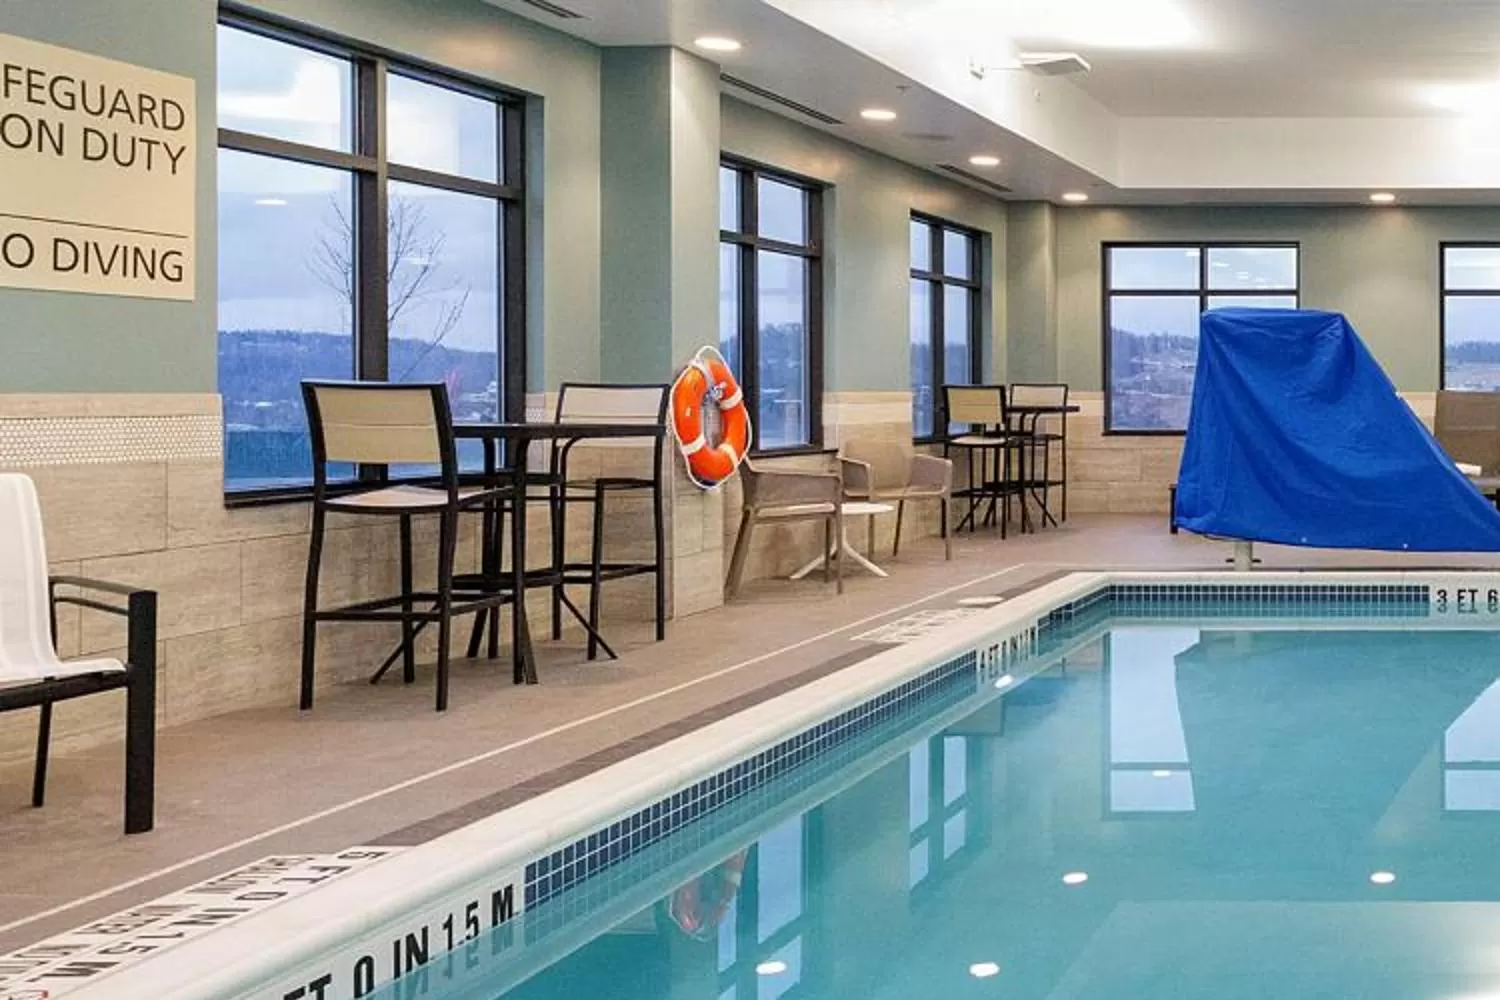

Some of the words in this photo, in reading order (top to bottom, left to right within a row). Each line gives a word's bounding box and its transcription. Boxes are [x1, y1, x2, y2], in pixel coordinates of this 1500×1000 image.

[3, 63, 185, 131] FEGUARD
[1, 113, 64, 157] ON
[82, 126, 187, 175] DUTY
[2, 233, 35, 269] O
[52, 237, 184, 282] DIVING
[1436, 588, 1449, 604] 3
[1456, 588, 1479, 604] FT
[1487, 588, 1500, 604] 6
